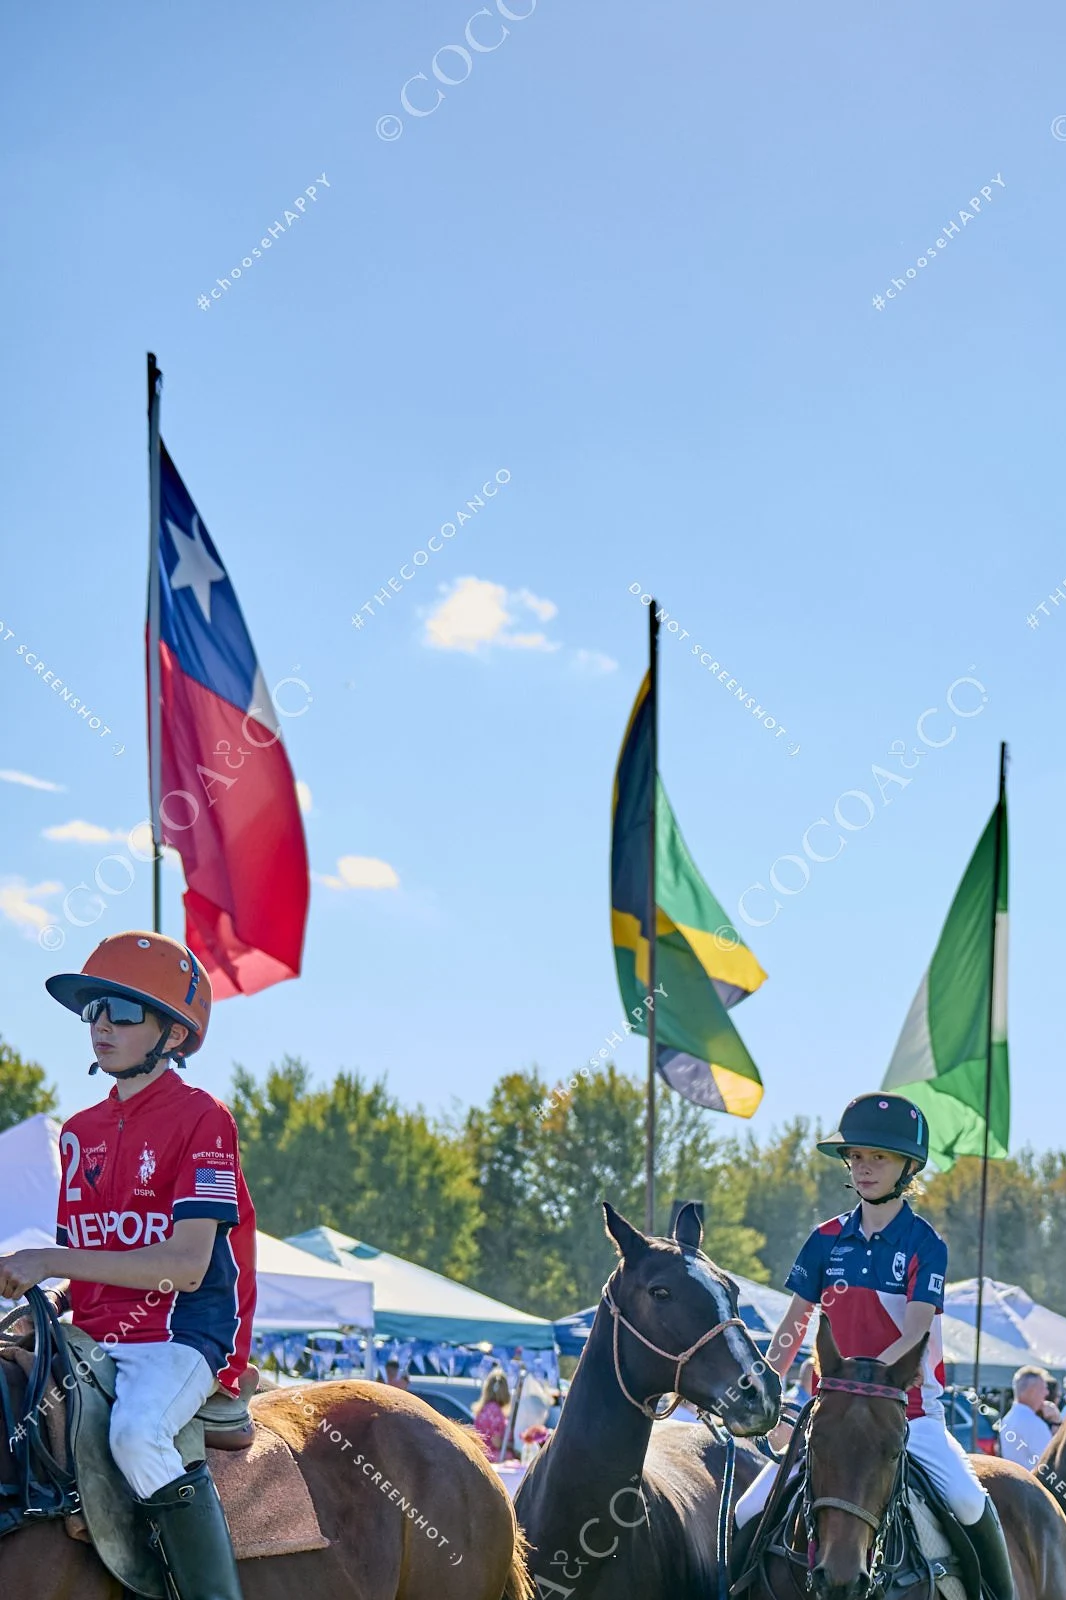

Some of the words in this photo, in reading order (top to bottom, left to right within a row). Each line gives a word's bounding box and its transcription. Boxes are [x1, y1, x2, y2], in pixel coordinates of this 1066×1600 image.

[60, 1131, 82, 1202] 2
[133, 1188, 156, 1197] USPA
[67, 1210, 174, 1248] NEWPOR
